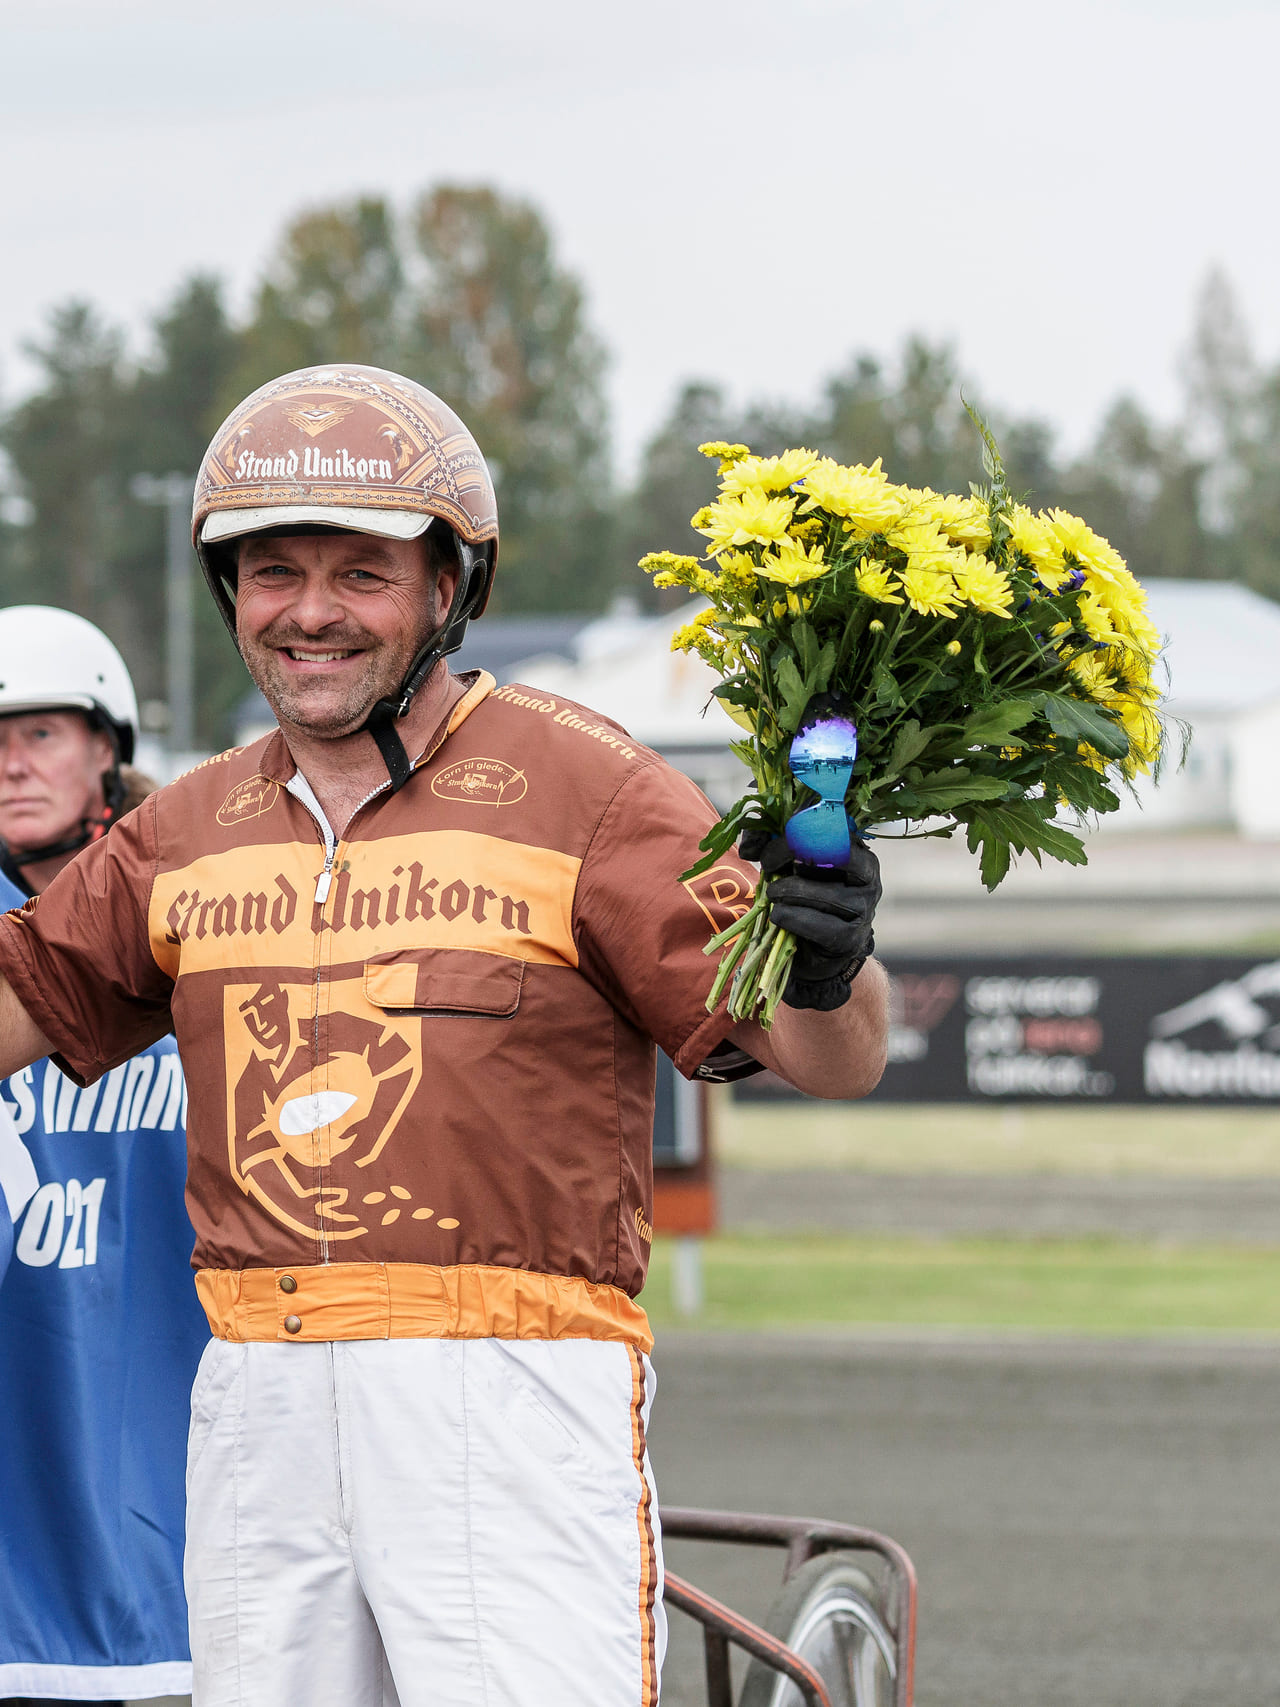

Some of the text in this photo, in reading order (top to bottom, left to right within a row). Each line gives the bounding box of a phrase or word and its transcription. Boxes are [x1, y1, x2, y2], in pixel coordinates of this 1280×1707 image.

[235, 447, 393, 480] Strand Unikorn
[490, 686, 637, 760] Strand Unikorn
[436, 768, 461, 784] Korn
[464, 762, 474, 770] til
[166, 861, 533, 945] Strand Unikorn
[16, 1177, 107, 1270] 021
